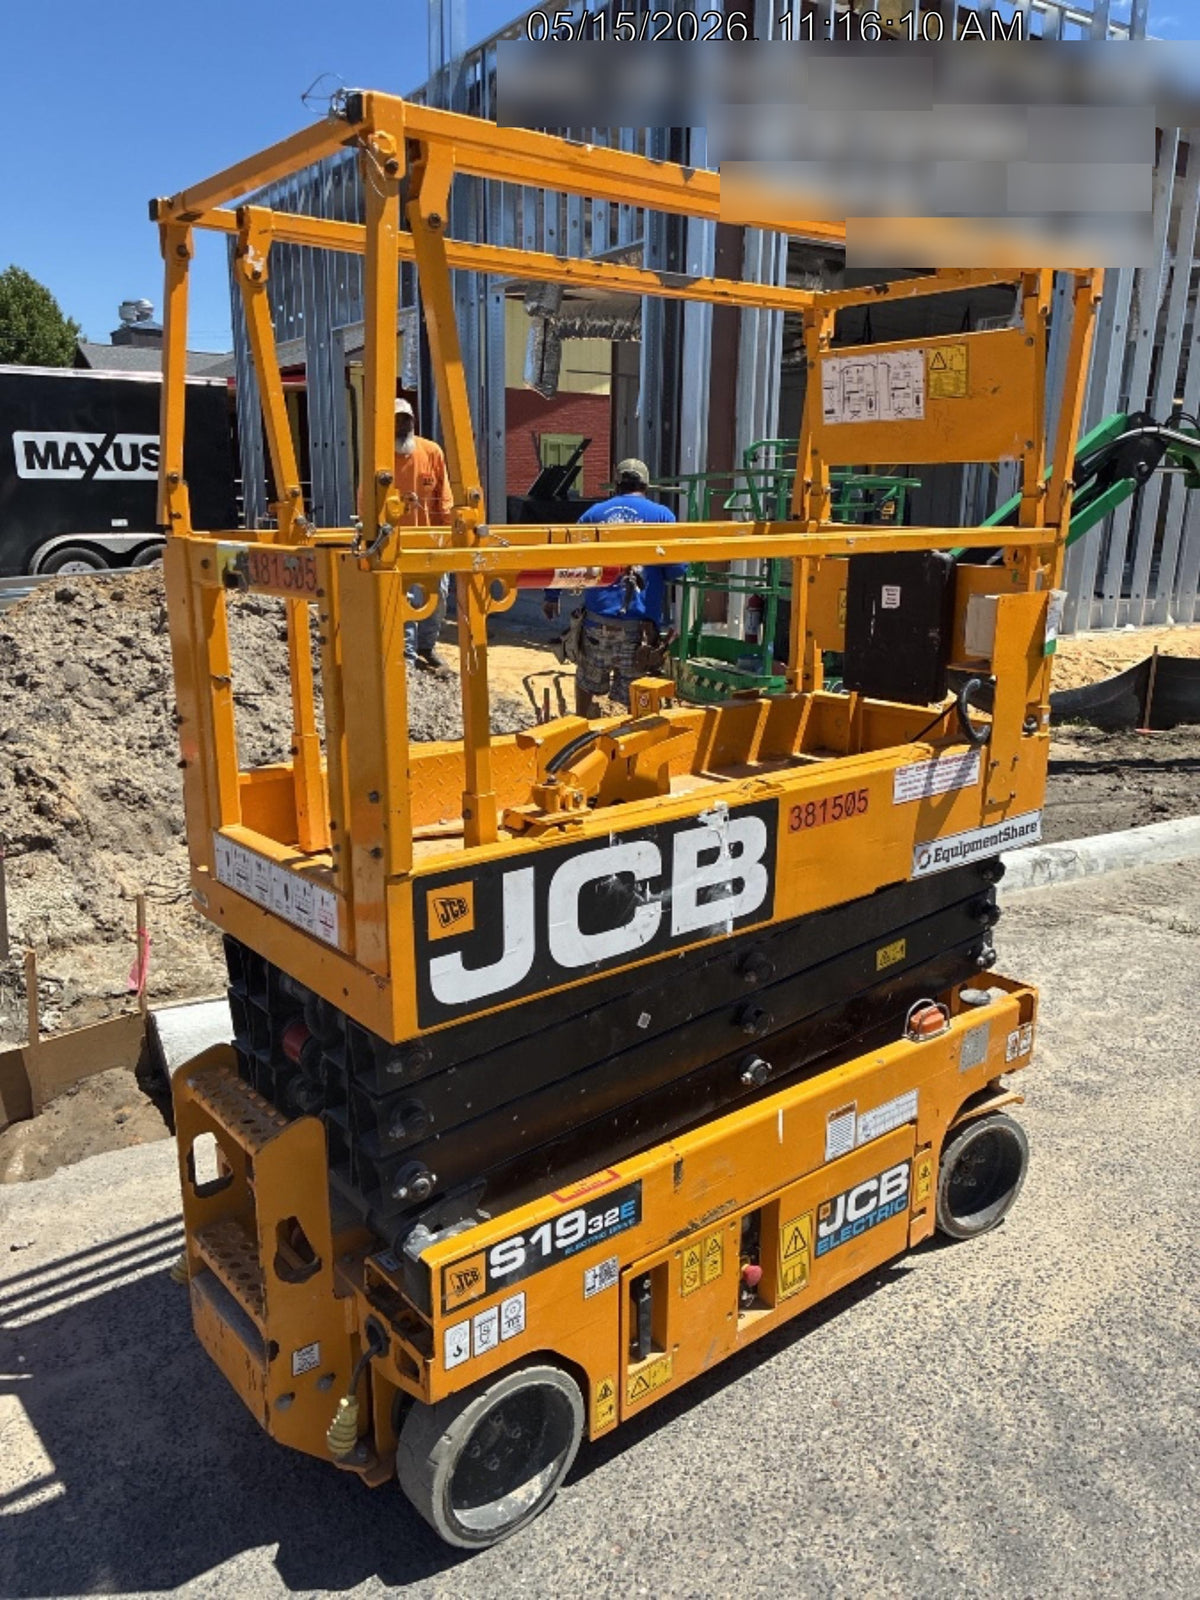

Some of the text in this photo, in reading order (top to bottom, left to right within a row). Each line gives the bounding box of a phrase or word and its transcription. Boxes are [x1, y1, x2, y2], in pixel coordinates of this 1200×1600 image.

[23, 433, 160, 480] MAXUS
[790, 788, 869, 831] 381505
[933, 821, 1038, 863] EquipmentShare
[429, 814, 768, 1005] JCB
[439, 899, 467, 923] JCB
[818, 1163, 910, 1238] JCB
[816, 1195, 907, 1256] ELECTRIC
[455, 1269, 480, 1291] JCB
